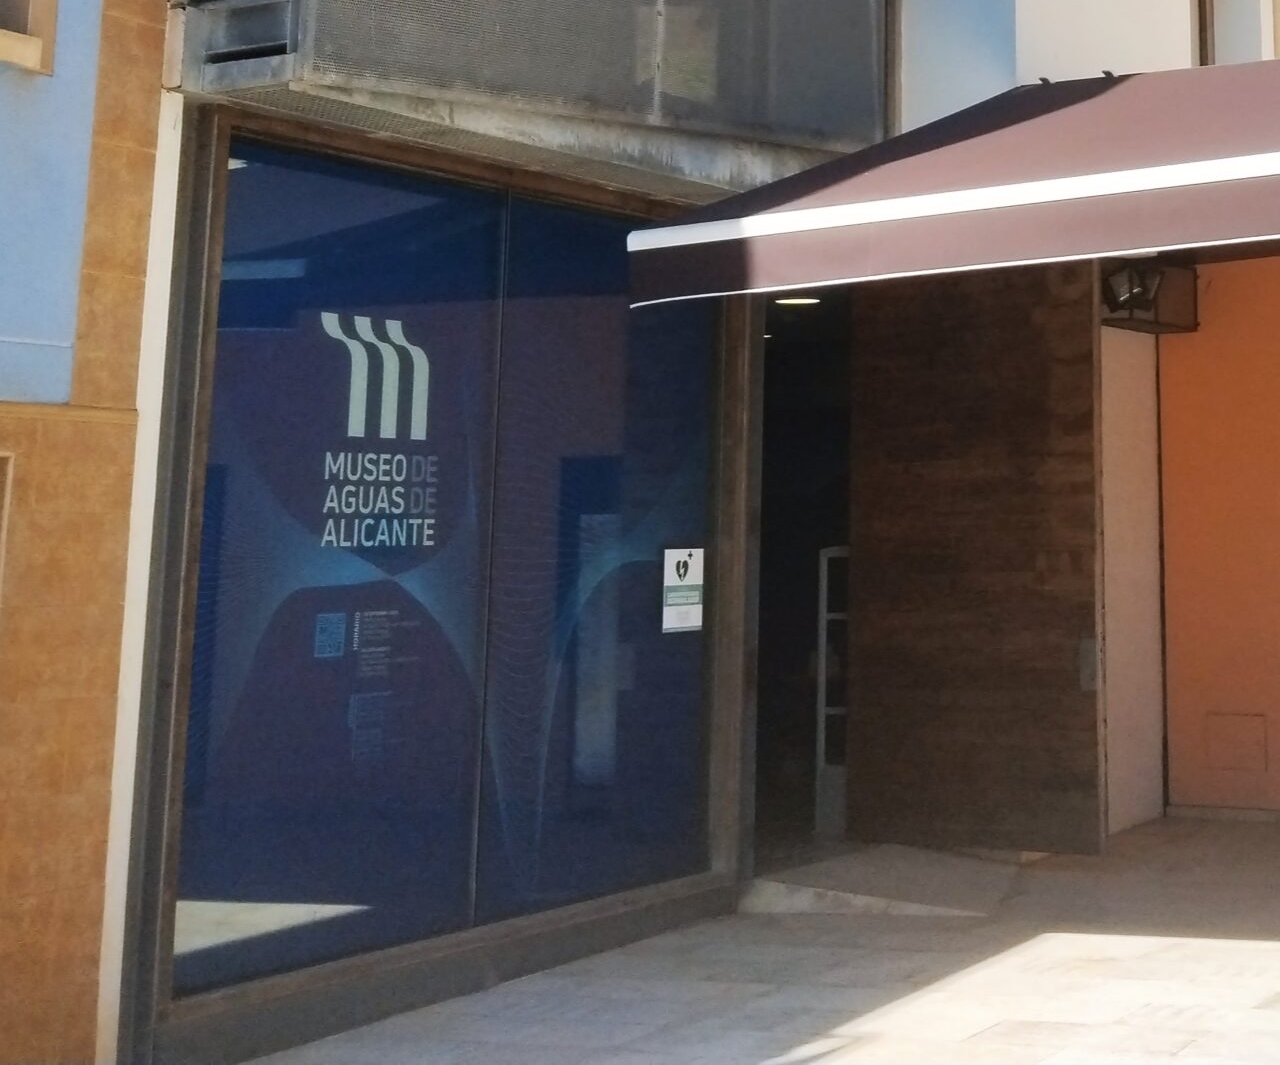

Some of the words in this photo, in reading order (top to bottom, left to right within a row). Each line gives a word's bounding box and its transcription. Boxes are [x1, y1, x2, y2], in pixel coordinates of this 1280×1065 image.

[324, 451, 407, 482] MUSEO
[411, 455, 439, 483] DE
[322, 485, 405, 514] AGUAS
[408, 486, 437, 514] DE
[320, 518, 436, 547] ALICANTE
